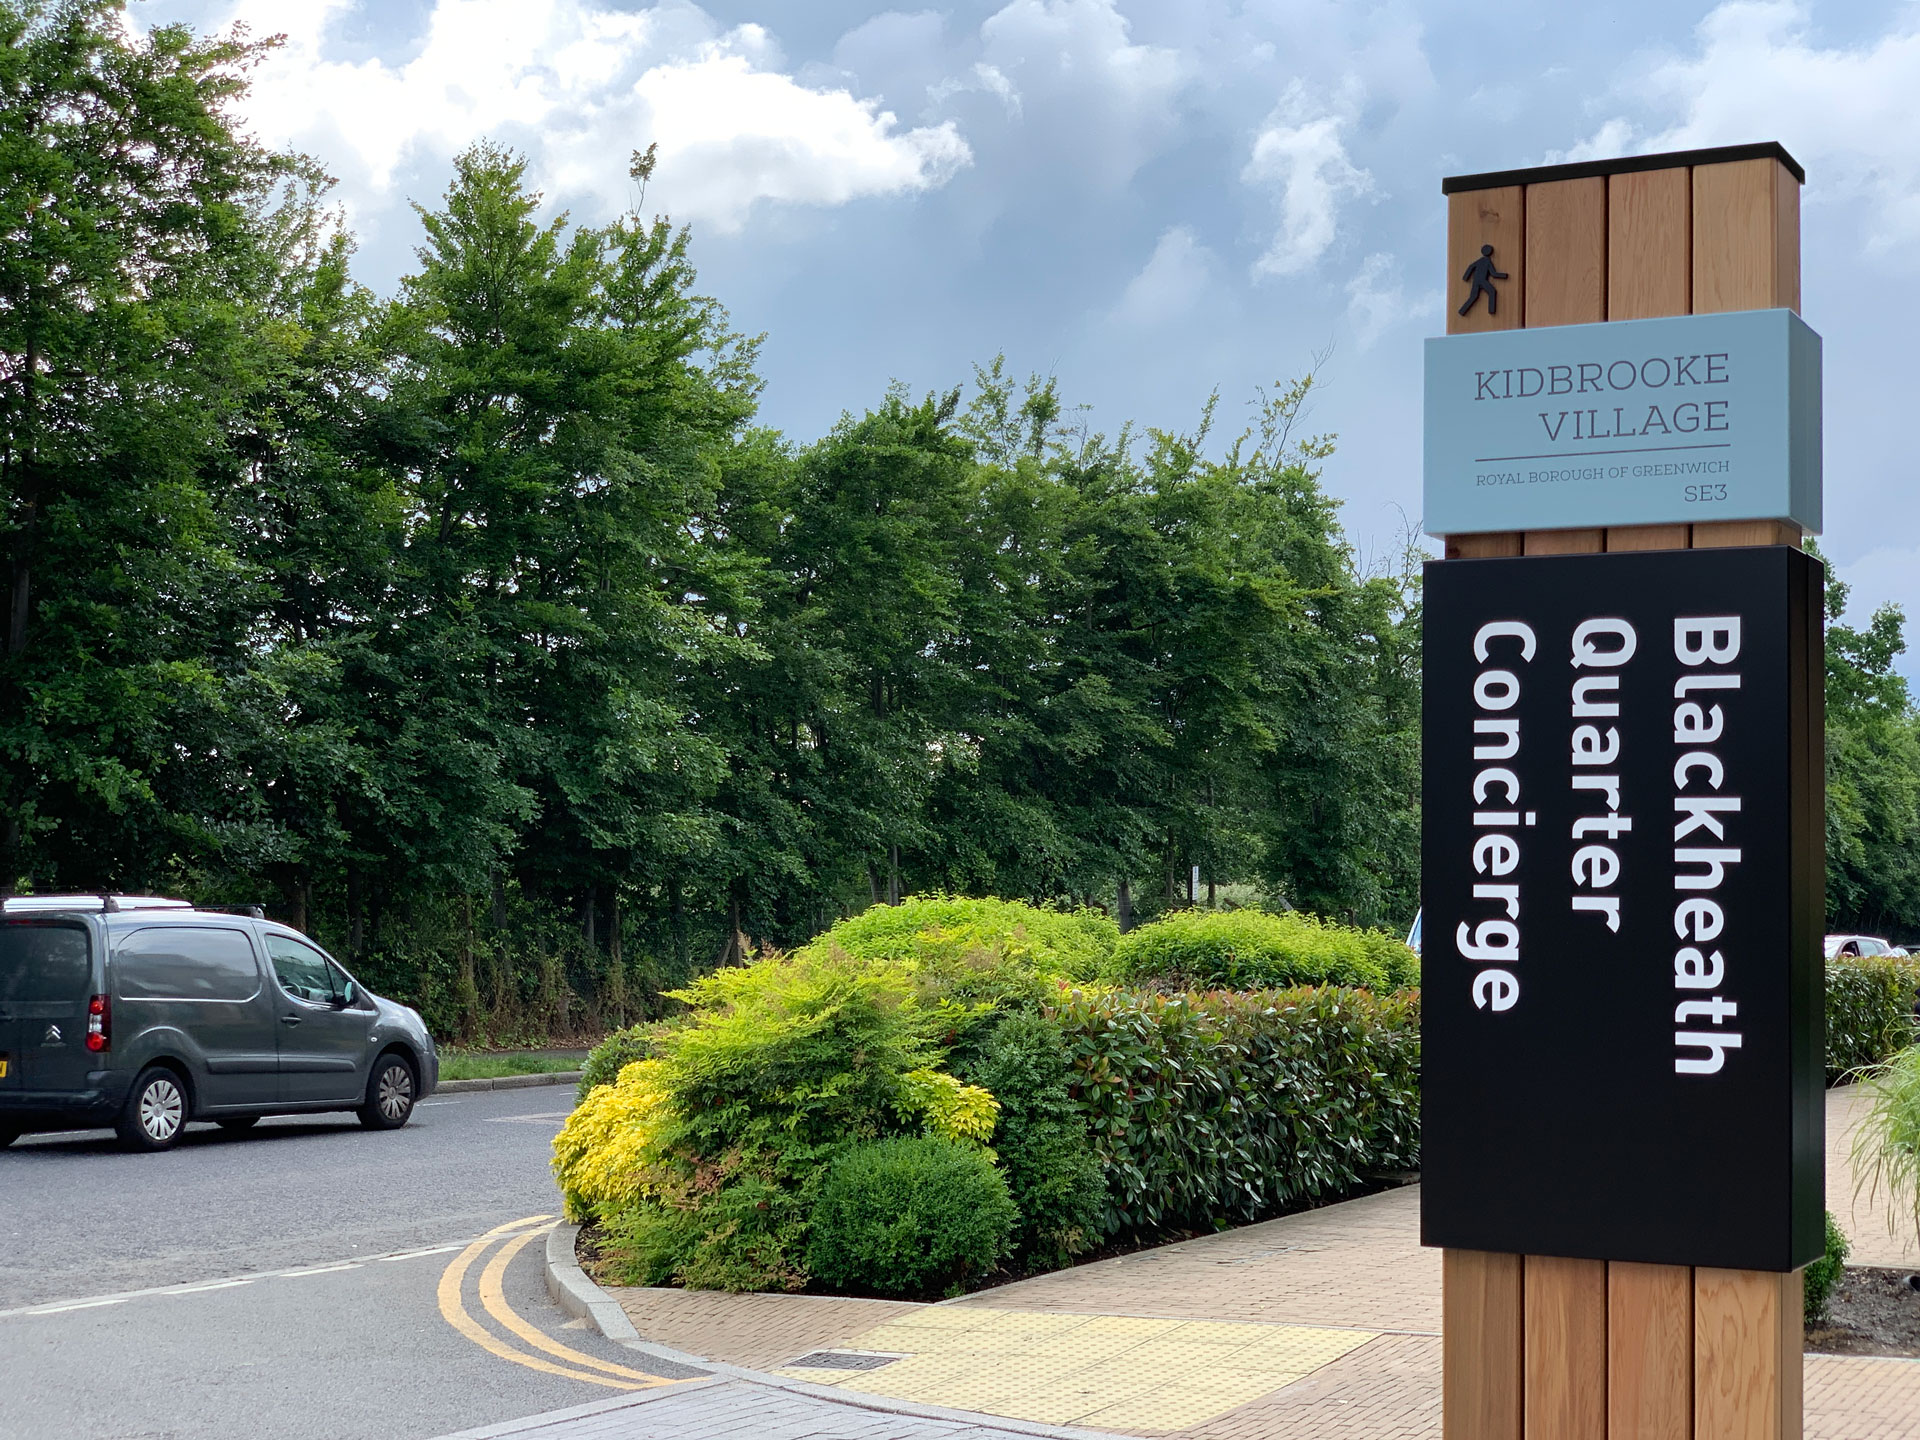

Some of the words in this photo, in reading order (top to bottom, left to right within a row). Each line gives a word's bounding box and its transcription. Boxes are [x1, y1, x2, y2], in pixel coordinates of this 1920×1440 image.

[1474, 353, 1730, 401] KIDBROOKE
[1538, 400, 1730, 442] VILLAGE
[1476, 473, 1525, 487] ROYAL
[1529, 467, 1604, 484] BOROUGH
[1608, 466, 1629, 479] OF
[1632, 460, 1730, 478] GREENWICH
[1684, 484, 1729, 503] SE3
[1569, 617, 1637, 934] Quarter
[1456, 621, 1537, 1012] Concierge
[1673, 615, 1743, 1075] Blackheath
